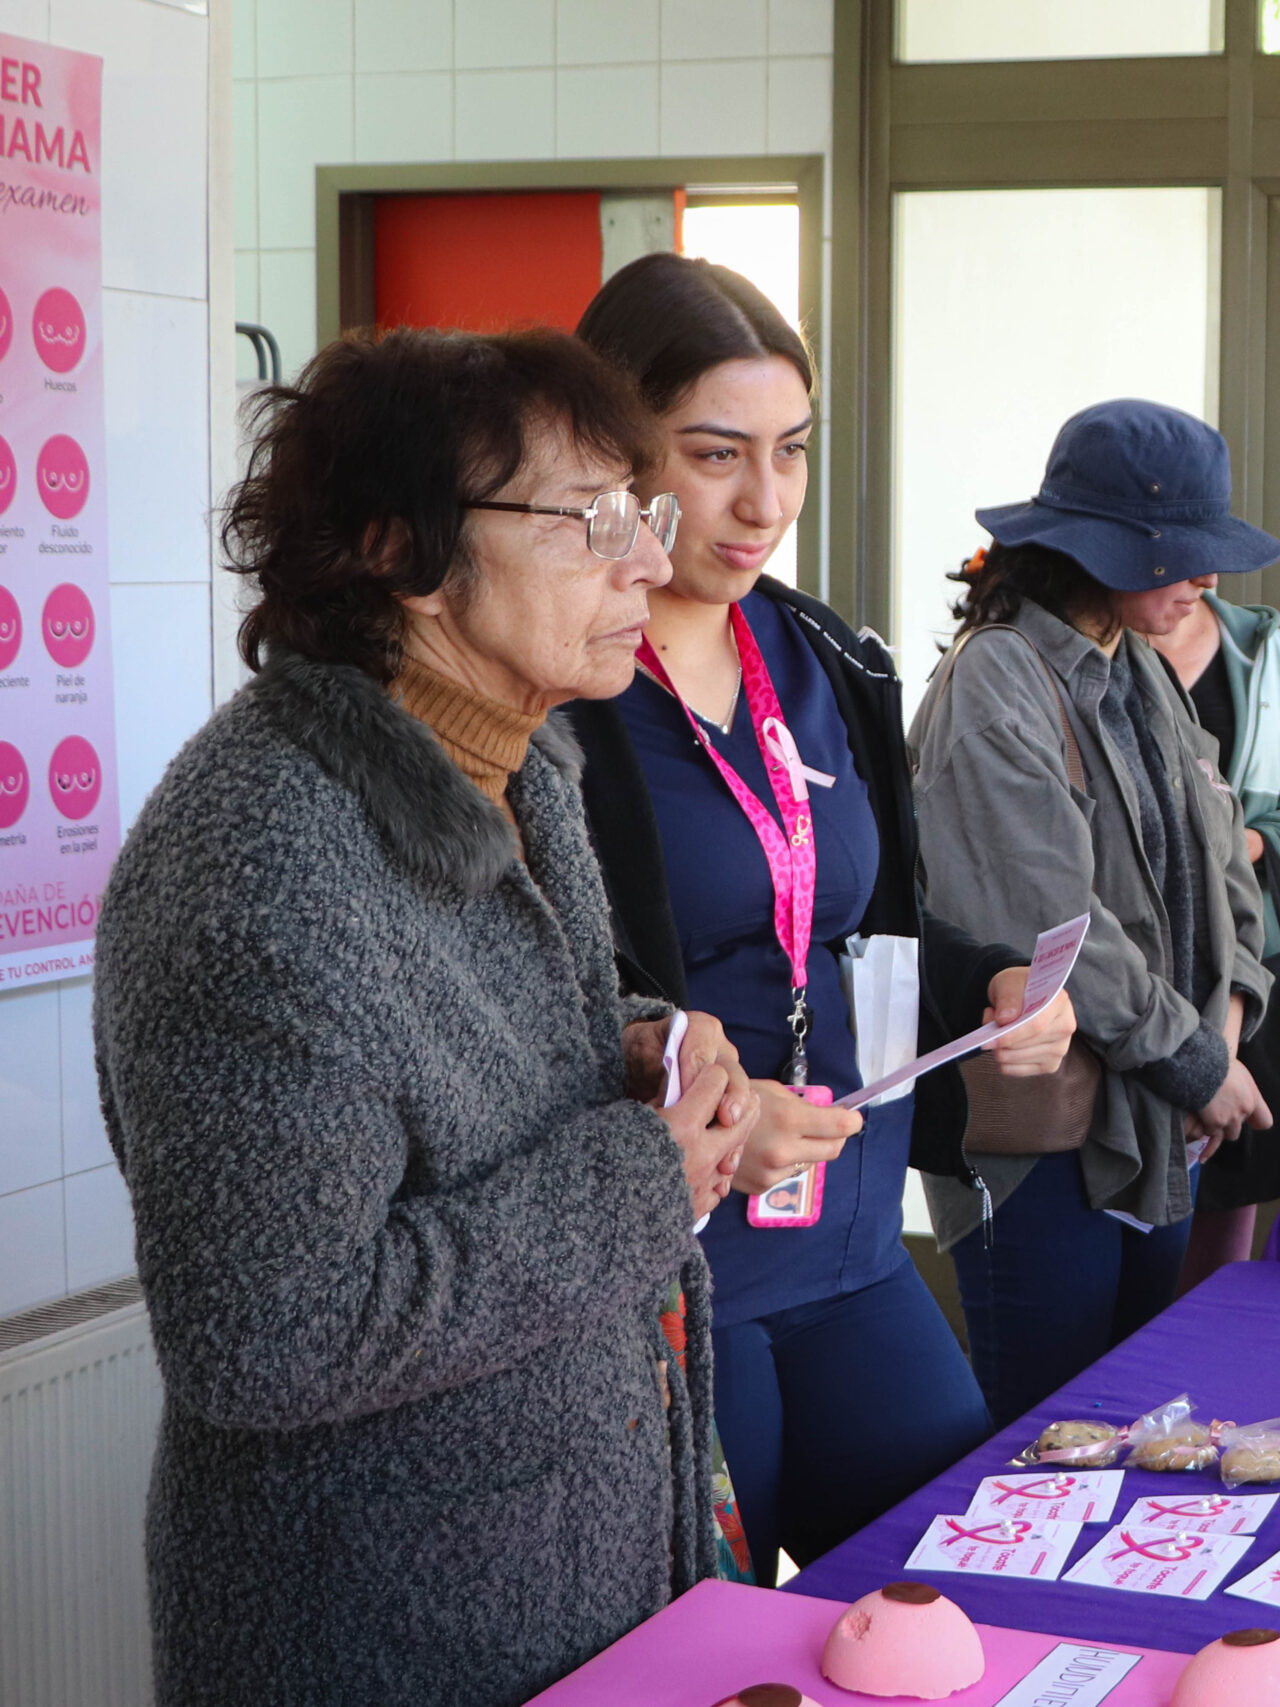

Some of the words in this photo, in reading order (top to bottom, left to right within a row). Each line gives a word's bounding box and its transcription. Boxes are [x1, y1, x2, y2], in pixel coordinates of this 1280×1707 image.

[1, 56, 42, 108] ER
[56, 825, 99, 839] Erosiones
[25, 956, 77, 976] CONTROL
